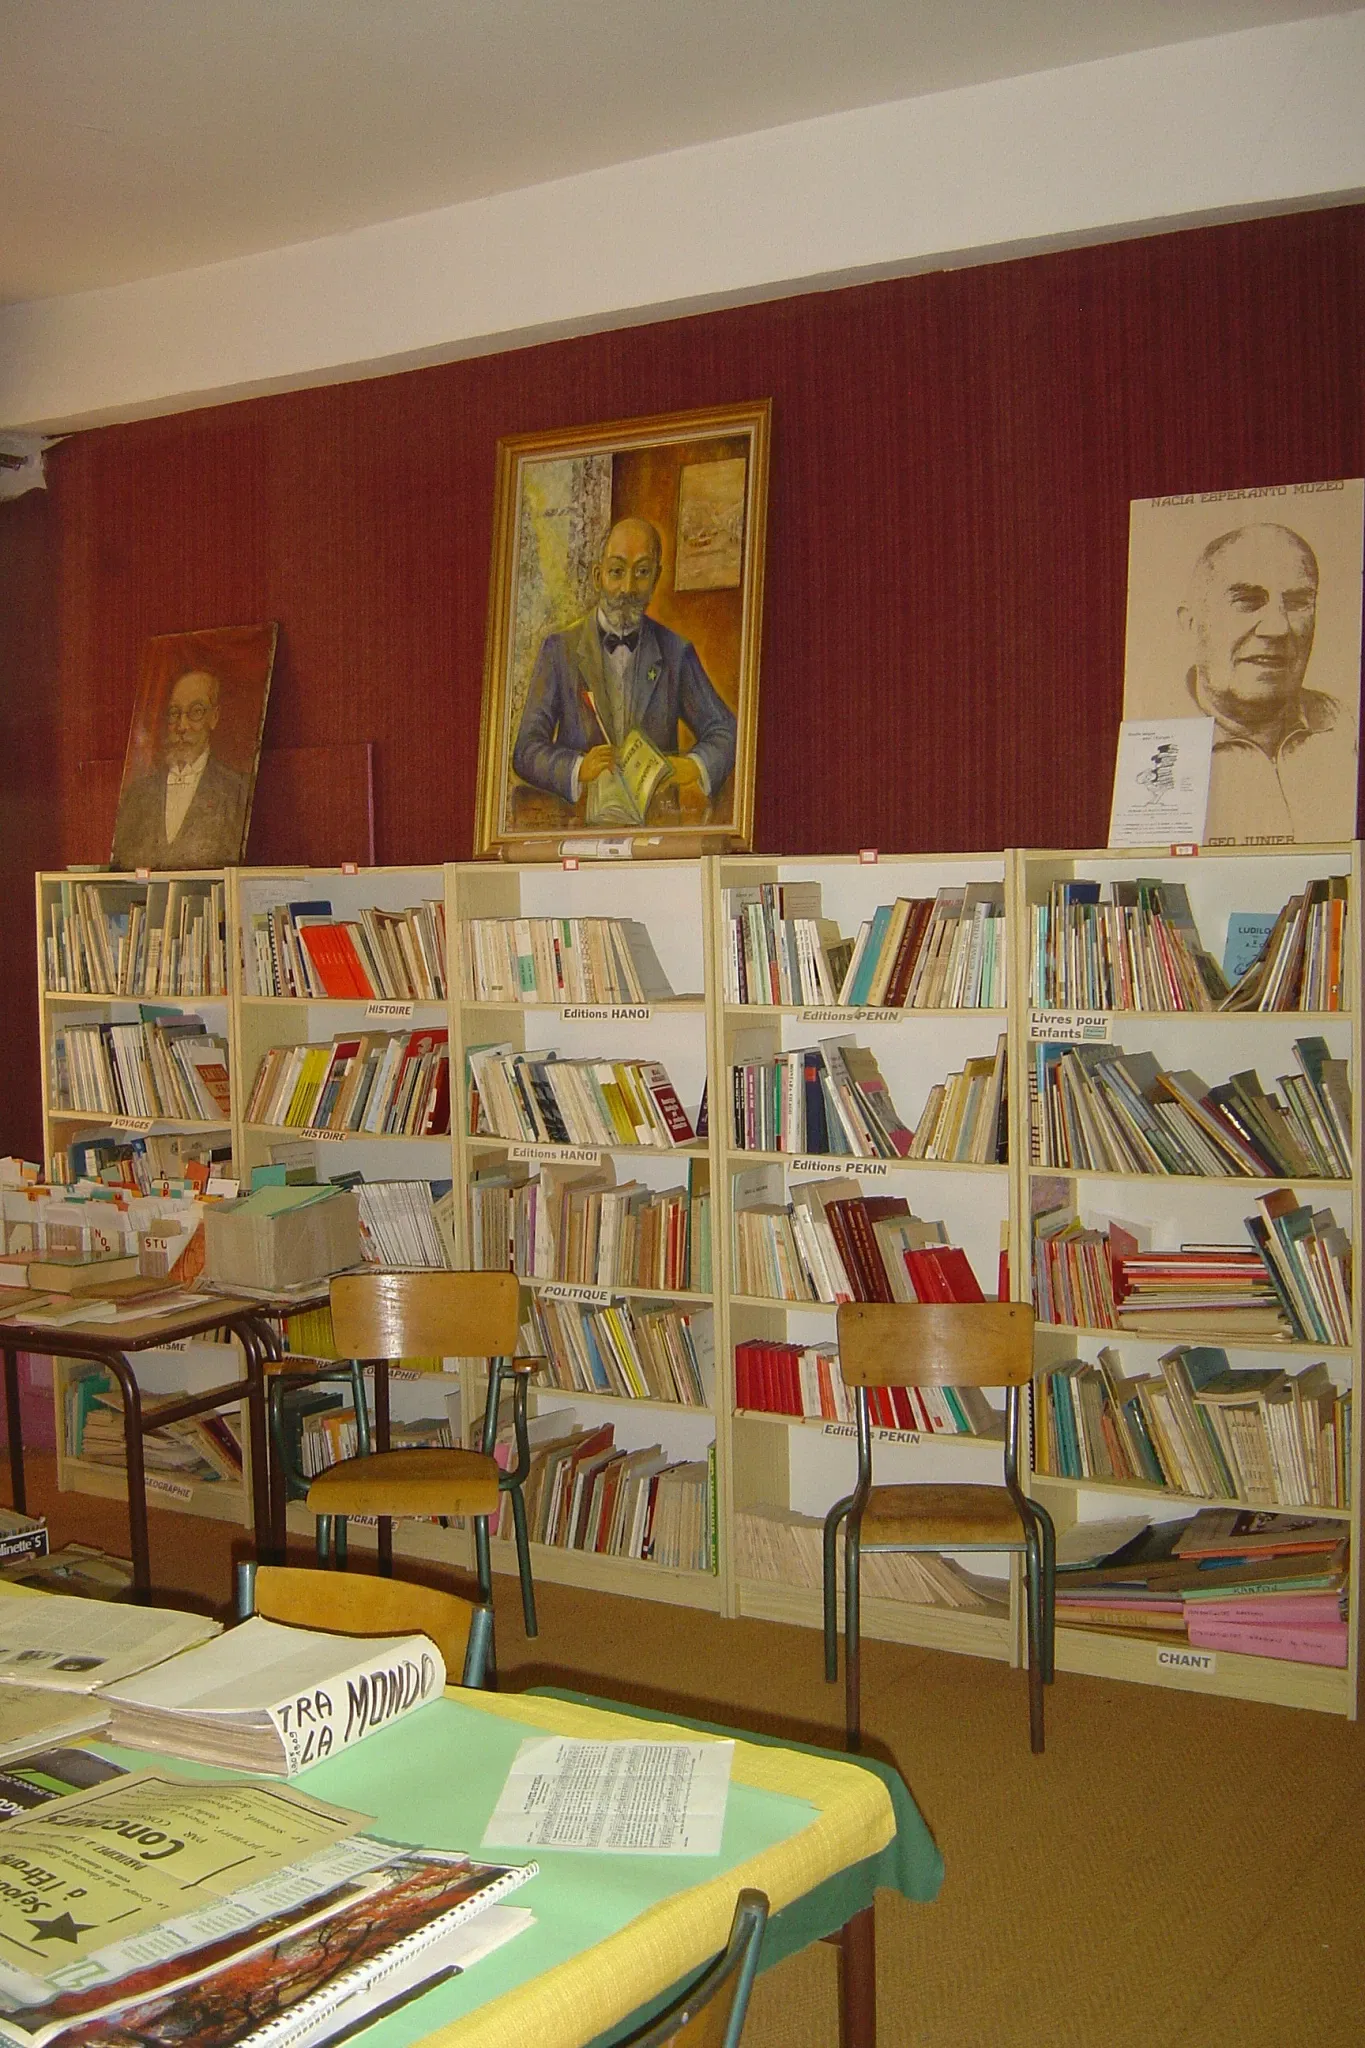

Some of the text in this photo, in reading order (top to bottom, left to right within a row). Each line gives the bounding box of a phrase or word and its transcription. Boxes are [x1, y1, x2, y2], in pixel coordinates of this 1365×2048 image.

[1151, 479, 1345, 508] NACIA ESPERANTO MUZEO
[1208, 835, 1296, 847] GEO JUNIER
[367, 1003, 412, 1016] HISTOIRE
[563, 1008, 650, 1020] Editions HANOI
[802, 1010, 899, 1021] Editions PEKIN
[1031, 1012, 1109, 1027] Livres pour
[1031, 1026, 1082, 1039] Enfants
[114, 1117, 151, 1130] VOYAGES
[301, 1129, 346, 1141] HISTOIRE
[512, 1147, 598, 1161] Editions HANOI
[792, 1159, 888, 1175] Editions PEKIN
[544, 1286, 608, 1301] POLITIQUE
[879, 1430, 920, 1444] PEKIN
[1158, 1652, 1212, 1669] CHANT
[344, 1653, 436, 1743] MONDO
[277, 1690, 333, 1733] TRA
[300, 1725, 333, 1765] LA
[38, 1815, 185, 1861] Concours
[290, 1835, 309, 1844] Le
[263, 1849, 282, 1858] Le
[63, 1888, 88, 1901] à
